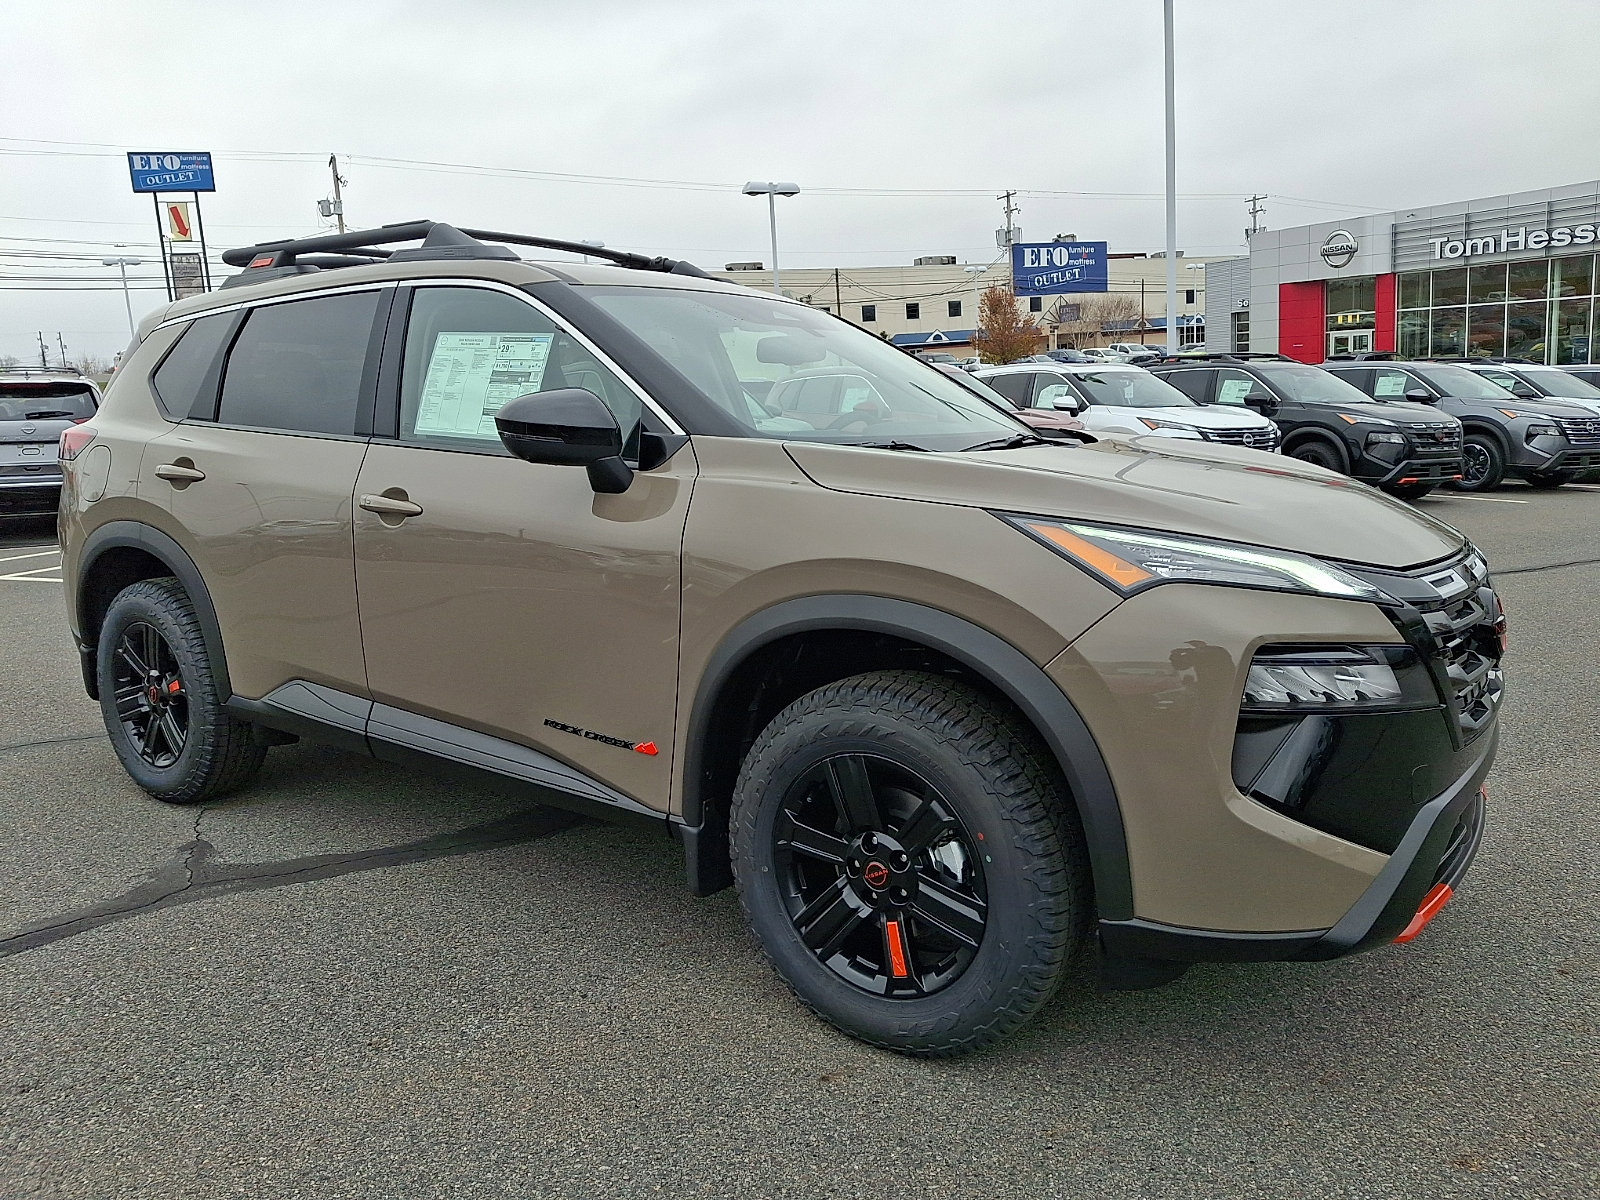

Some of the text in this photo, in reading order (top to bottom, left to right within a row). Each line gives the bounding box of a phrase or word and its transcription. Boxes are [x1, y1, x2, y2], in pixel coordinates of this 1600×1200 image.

[132, 154, 180, 170] EFO
[146, 171, 194, 185] OUTLET
[1428, 222, 1600, 259] Tom Hess
[1068, 246, 1095, 254] furniture
[1322, 244, 1353, 253] NISSAN
[1023, 246, 1069, 268] EFO
[1068, 258, 1096, 266] mattress
[1034, 268, 1081, 287] OUTLET
[500, 344, 510, 353] 29
[543, 718, 635, 751] ROCK CREEK
